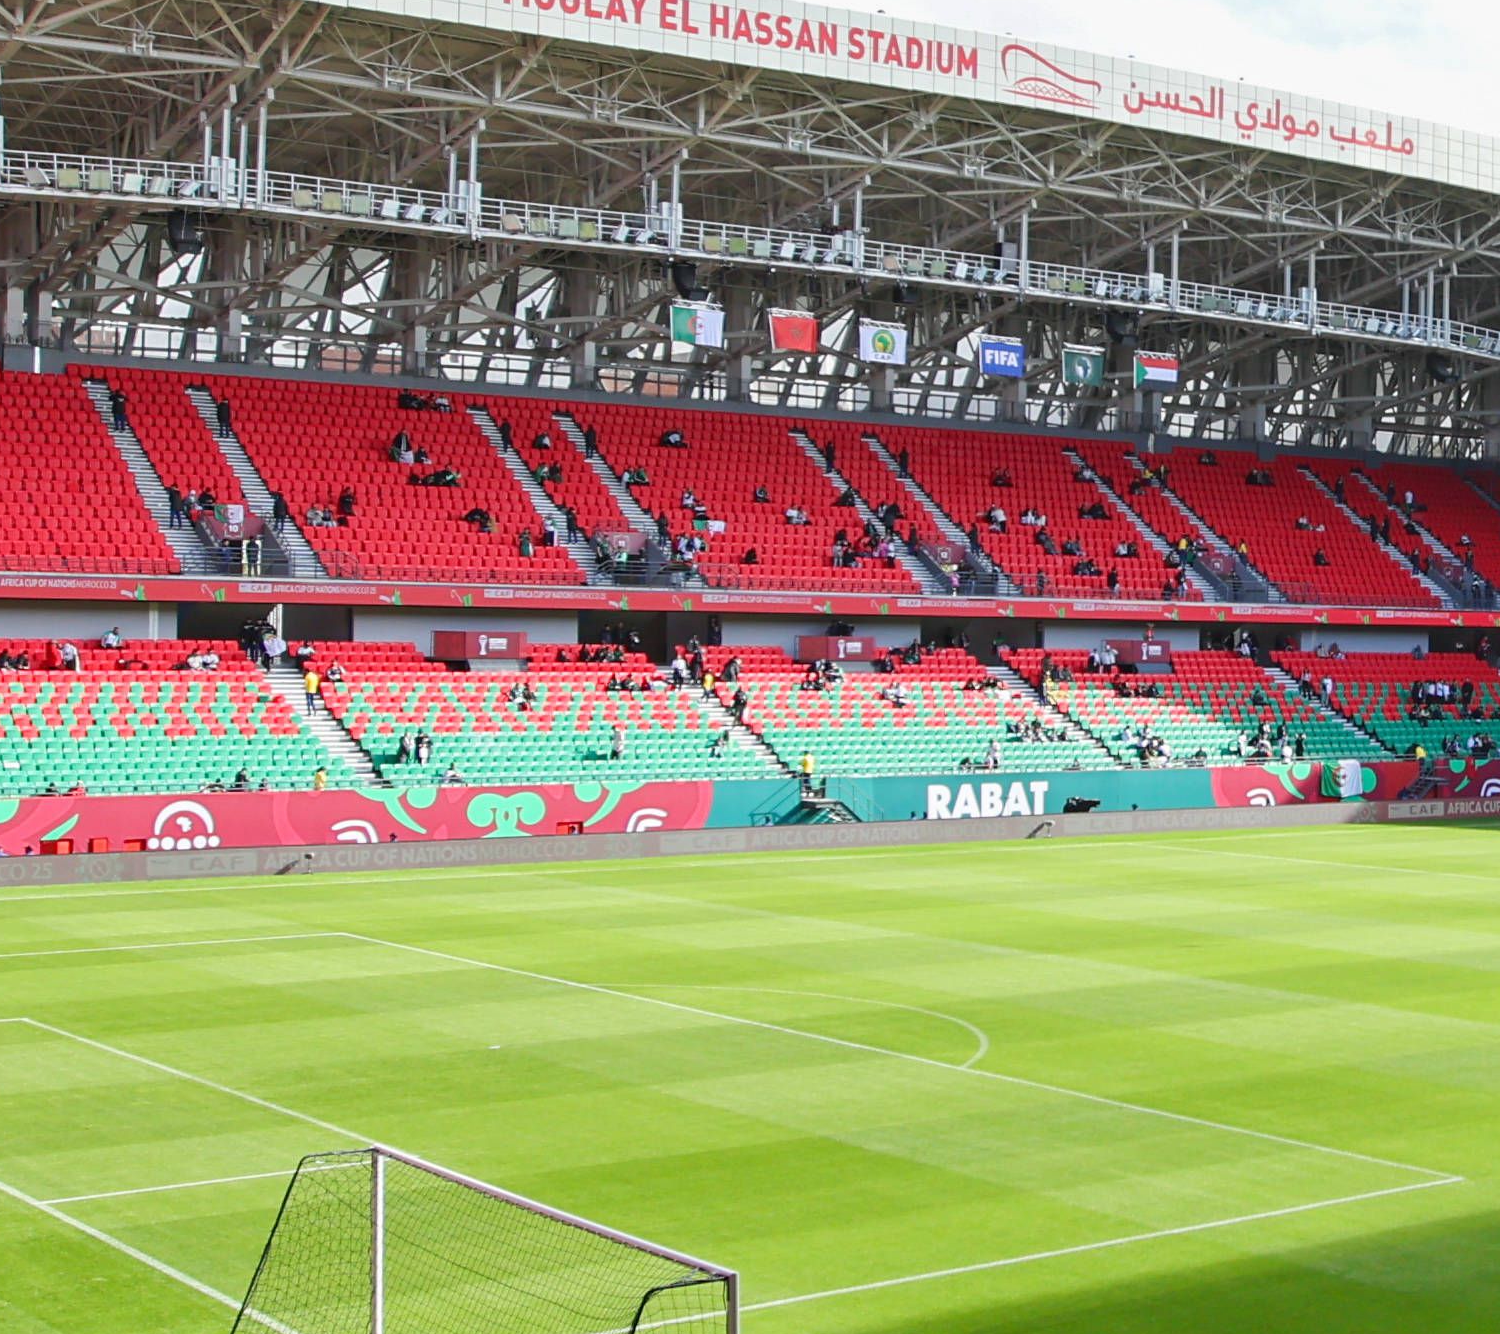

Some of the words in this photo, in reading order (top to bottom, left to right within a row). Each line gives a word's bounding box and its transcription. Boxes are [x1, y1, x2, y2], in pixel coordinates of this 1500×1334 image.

[710, 3, 838, 56] HASSAN
[848, 27, 978, 79] STADIUM
[1123, 81, 1224, 120] الحسن
[1235, 99, 1319, 141] مولاي
[1330, 121, 1414, 155] ملعب
[985, 349, 1018, 368] FIFA
[0, 578, 22, 587] AFRICA
[23, 579, 38, 587] CUP
[46, 579, 77, 588] NATIONS
[76, 580, 108, 589] MOROCCO
[926, 781, 1048, 820] RABAT
[1410, 804, 1438, 816] CAF
[1447, 802, 1484, 816] AFRICA
[751, 831, 804, 847] AFRICA
[807, 829, 835, 844] CUP
[837, 828, 855, 842] OF
[859, 825, 919, 842] NATIONS
[32, 861, 53, 878] 25
[189, 856, 247, 872] CAF
[334, 849, 368, 865] CUP
[371, 848, 397, 863] OF
[402, 845, 477, 862] NATIONS
[478, 843, 566, 862] MOROCCO
[570, 841, 588, 856] 25
